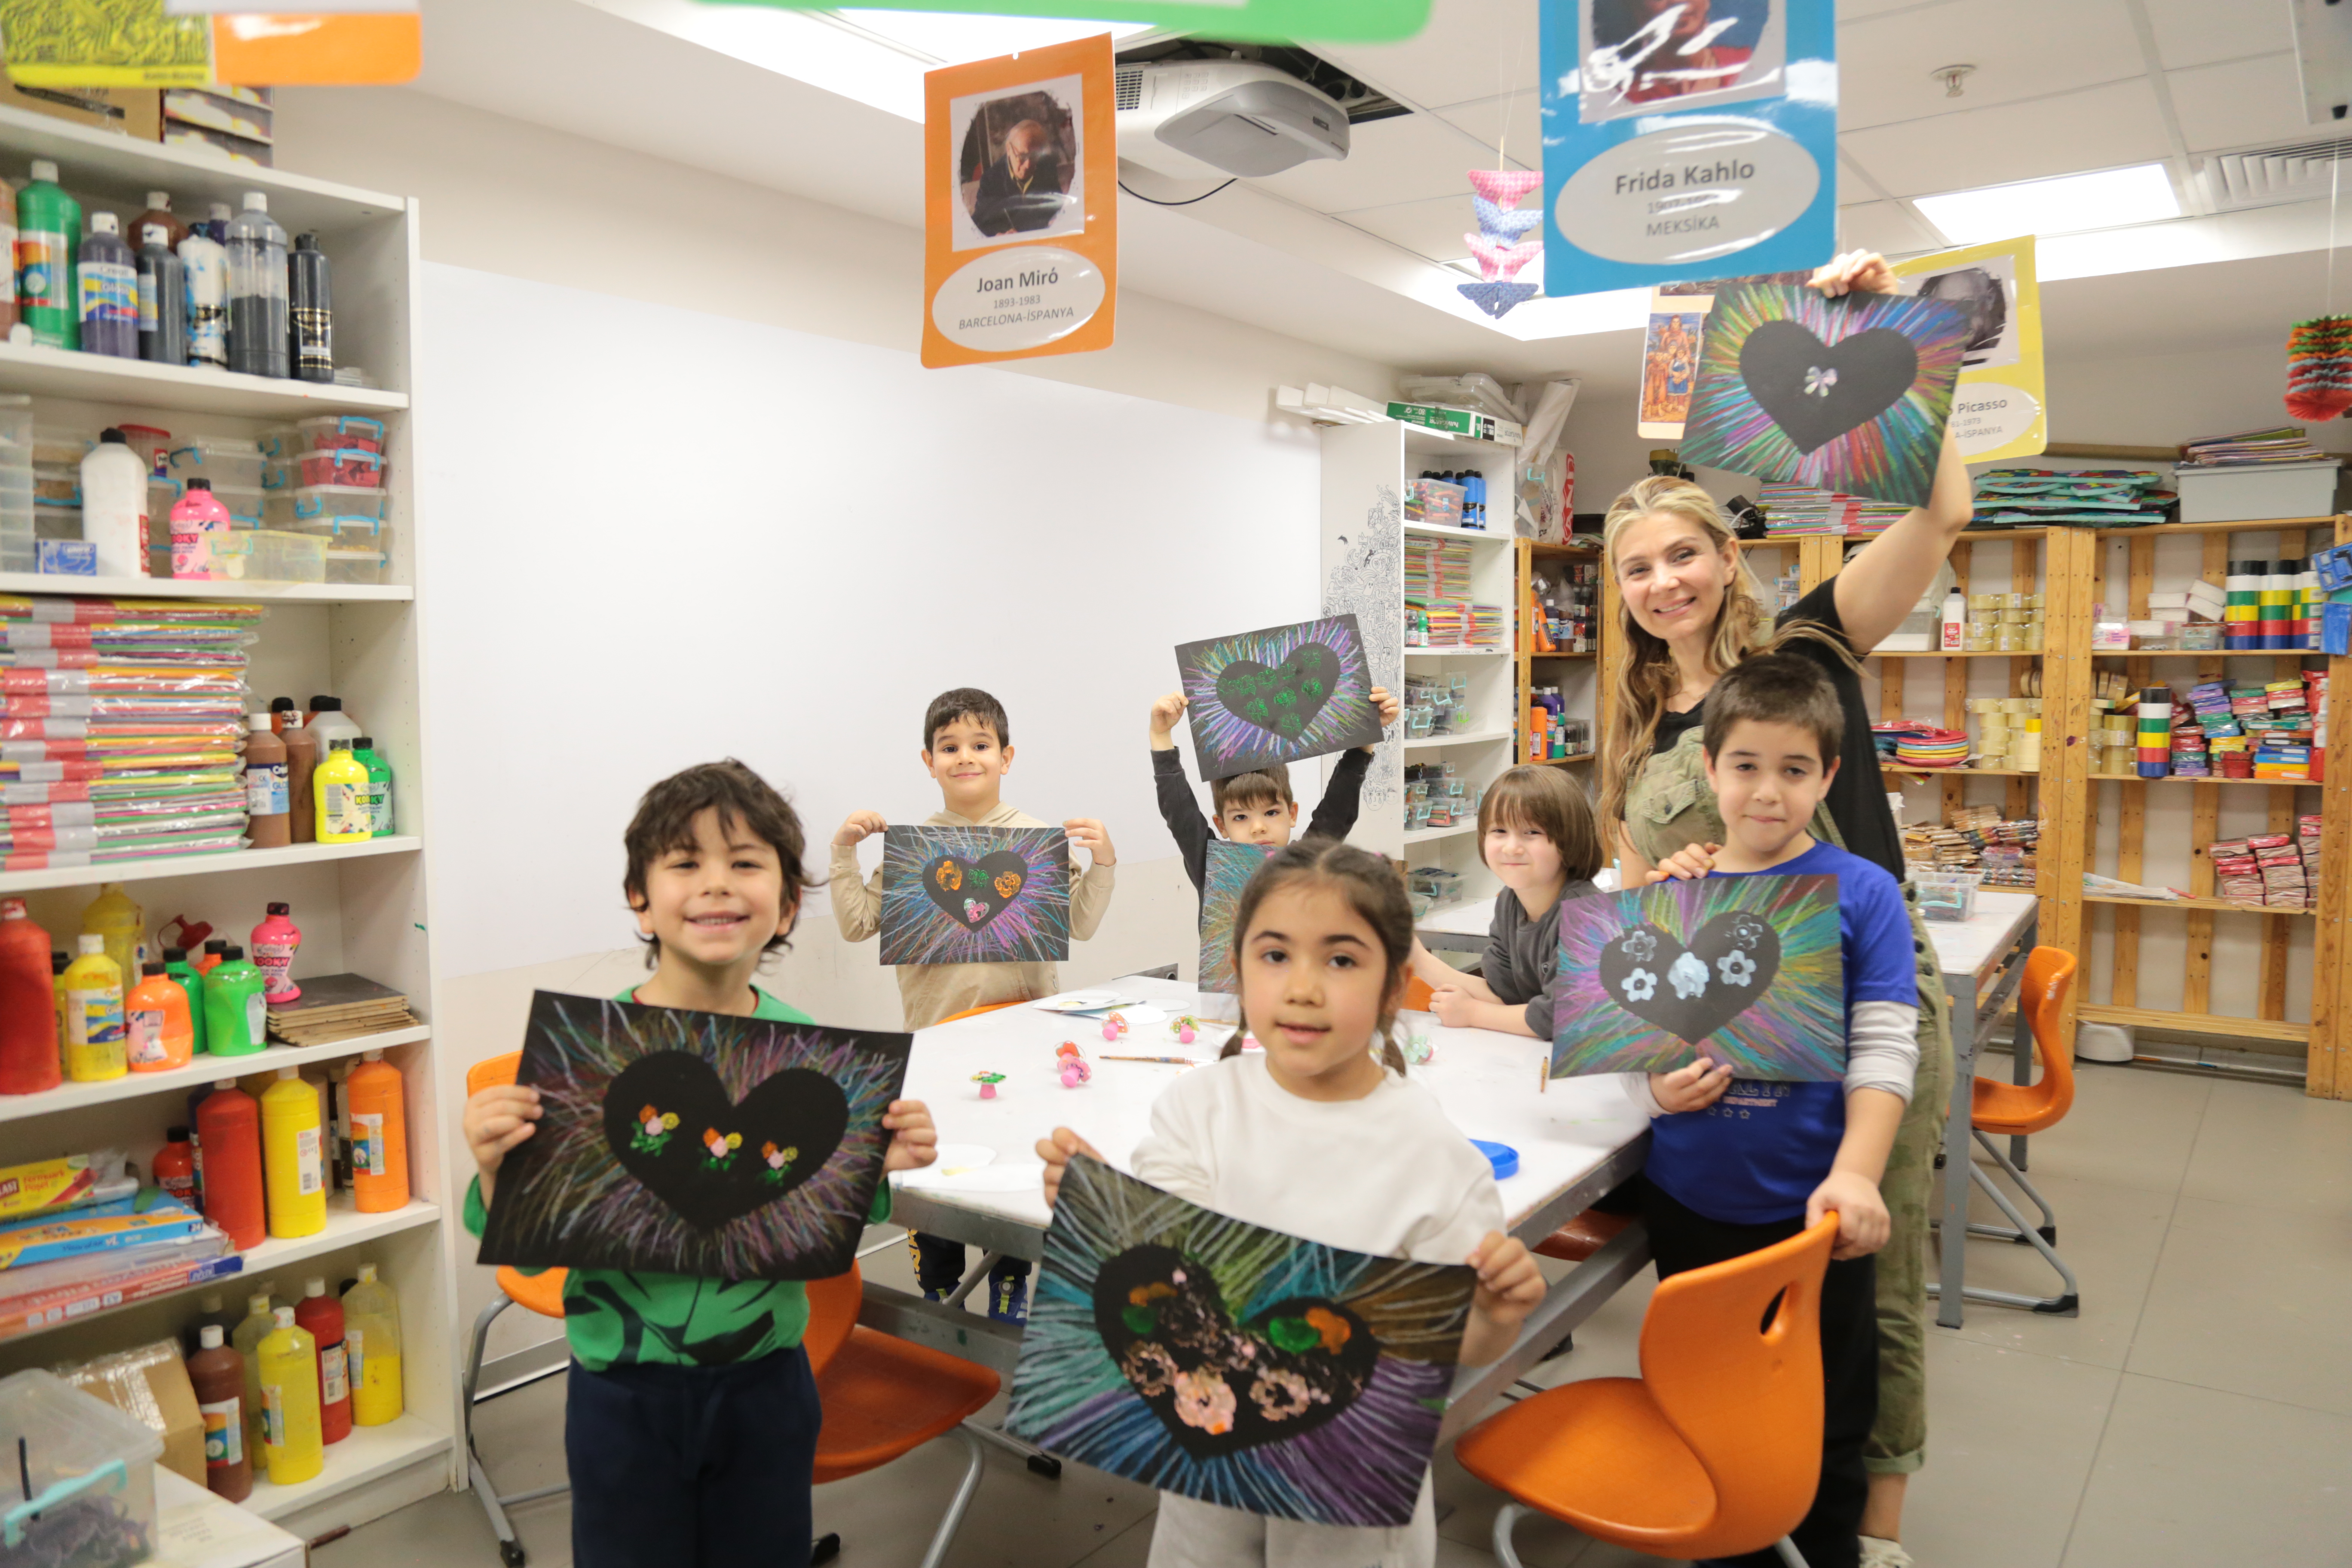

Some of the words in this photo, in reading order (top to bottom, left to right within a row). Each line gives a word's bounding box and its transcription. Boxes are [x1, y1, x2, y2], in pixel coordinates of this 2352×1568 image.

[1615, 169, 1675, 194] Frida
[1684, 159, 1755, 185] Kahlo
[1646, 215, 1720, 237] MEKSİKA
[977, 277, 1014, 293] Joan
[1019, 267, 1059, 287] Miró
[993, 295, 1041, 309] 1893-1983
[959, 306, 1074, 330] BARCELONA-İSPANYA
[1957, 399, 2008, 414] Picasso
